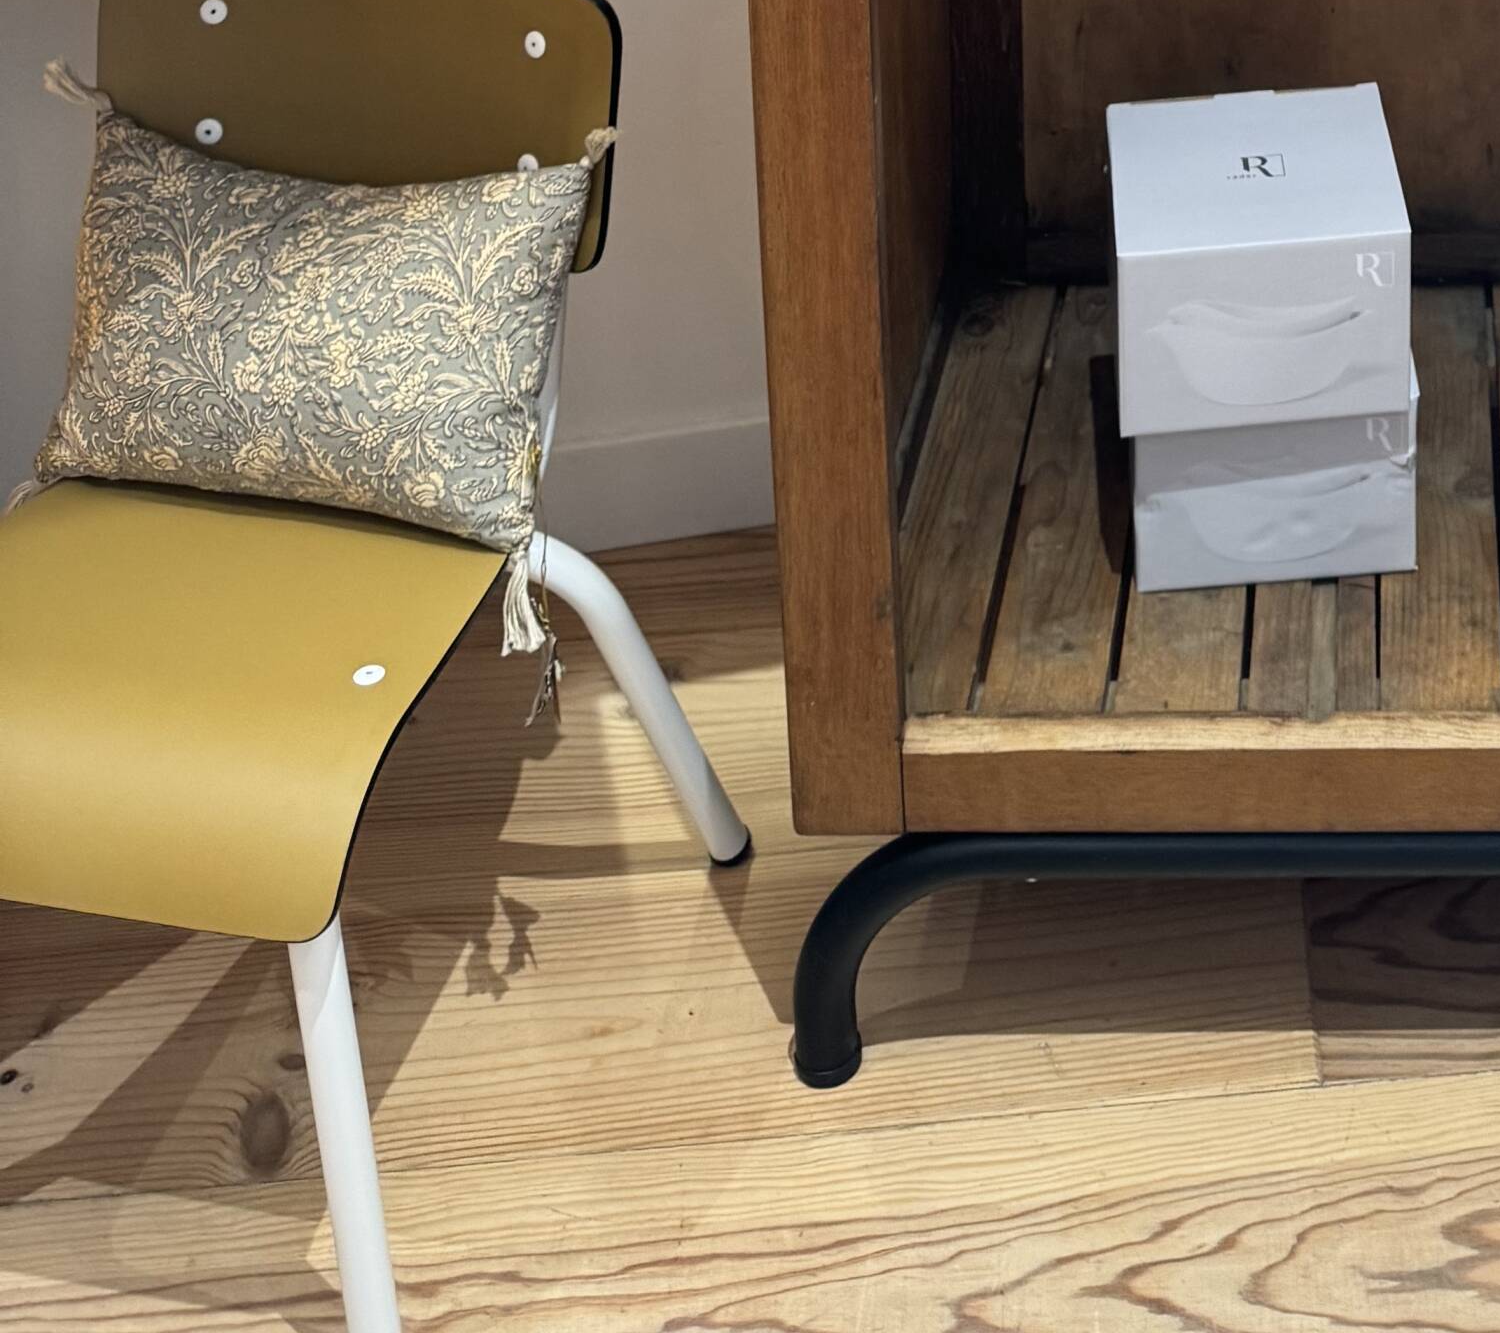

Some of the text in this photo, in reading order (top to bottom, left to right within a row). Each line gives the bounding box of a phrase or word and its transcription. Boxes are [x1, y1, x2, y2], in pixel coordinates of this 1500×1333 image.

[1240, 155, 1275, 178] R
[1355, 252, 1384, 287] R
[1366, 417, 1393, 451] R
